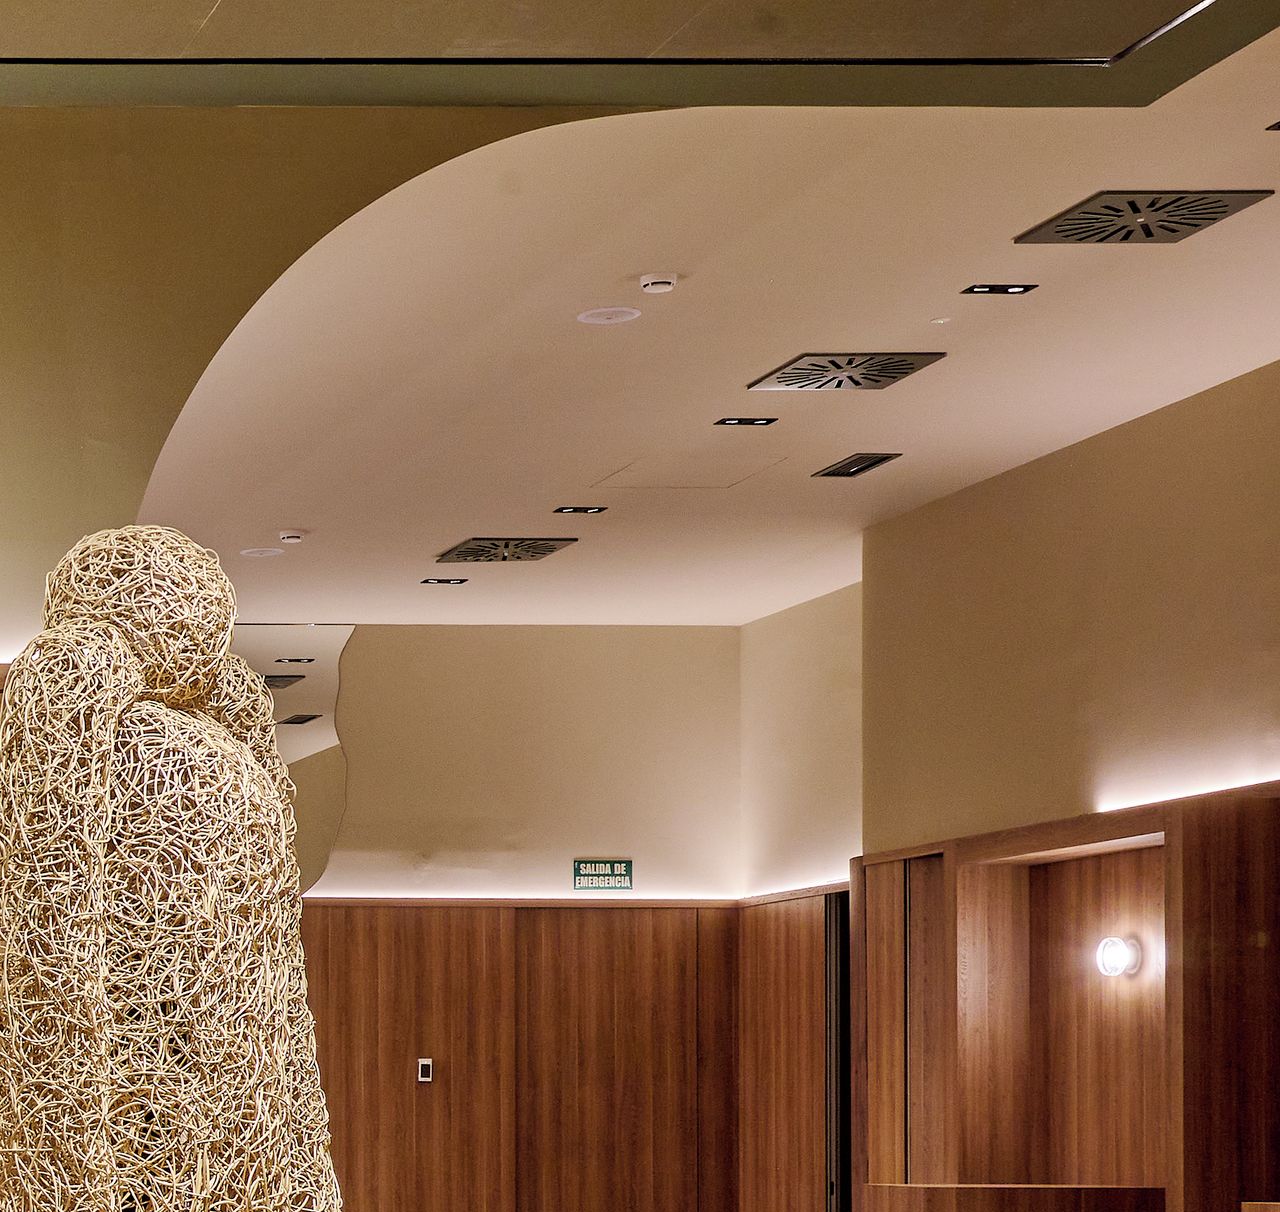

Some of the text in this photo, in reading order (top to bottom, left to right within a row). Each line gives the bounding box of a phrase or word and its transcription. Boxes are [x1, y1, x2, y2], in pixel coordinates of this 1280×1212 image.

[580, 864, 626, 875] SALIDA DE
[575, 876, 631, 888] EMERGENCIA
